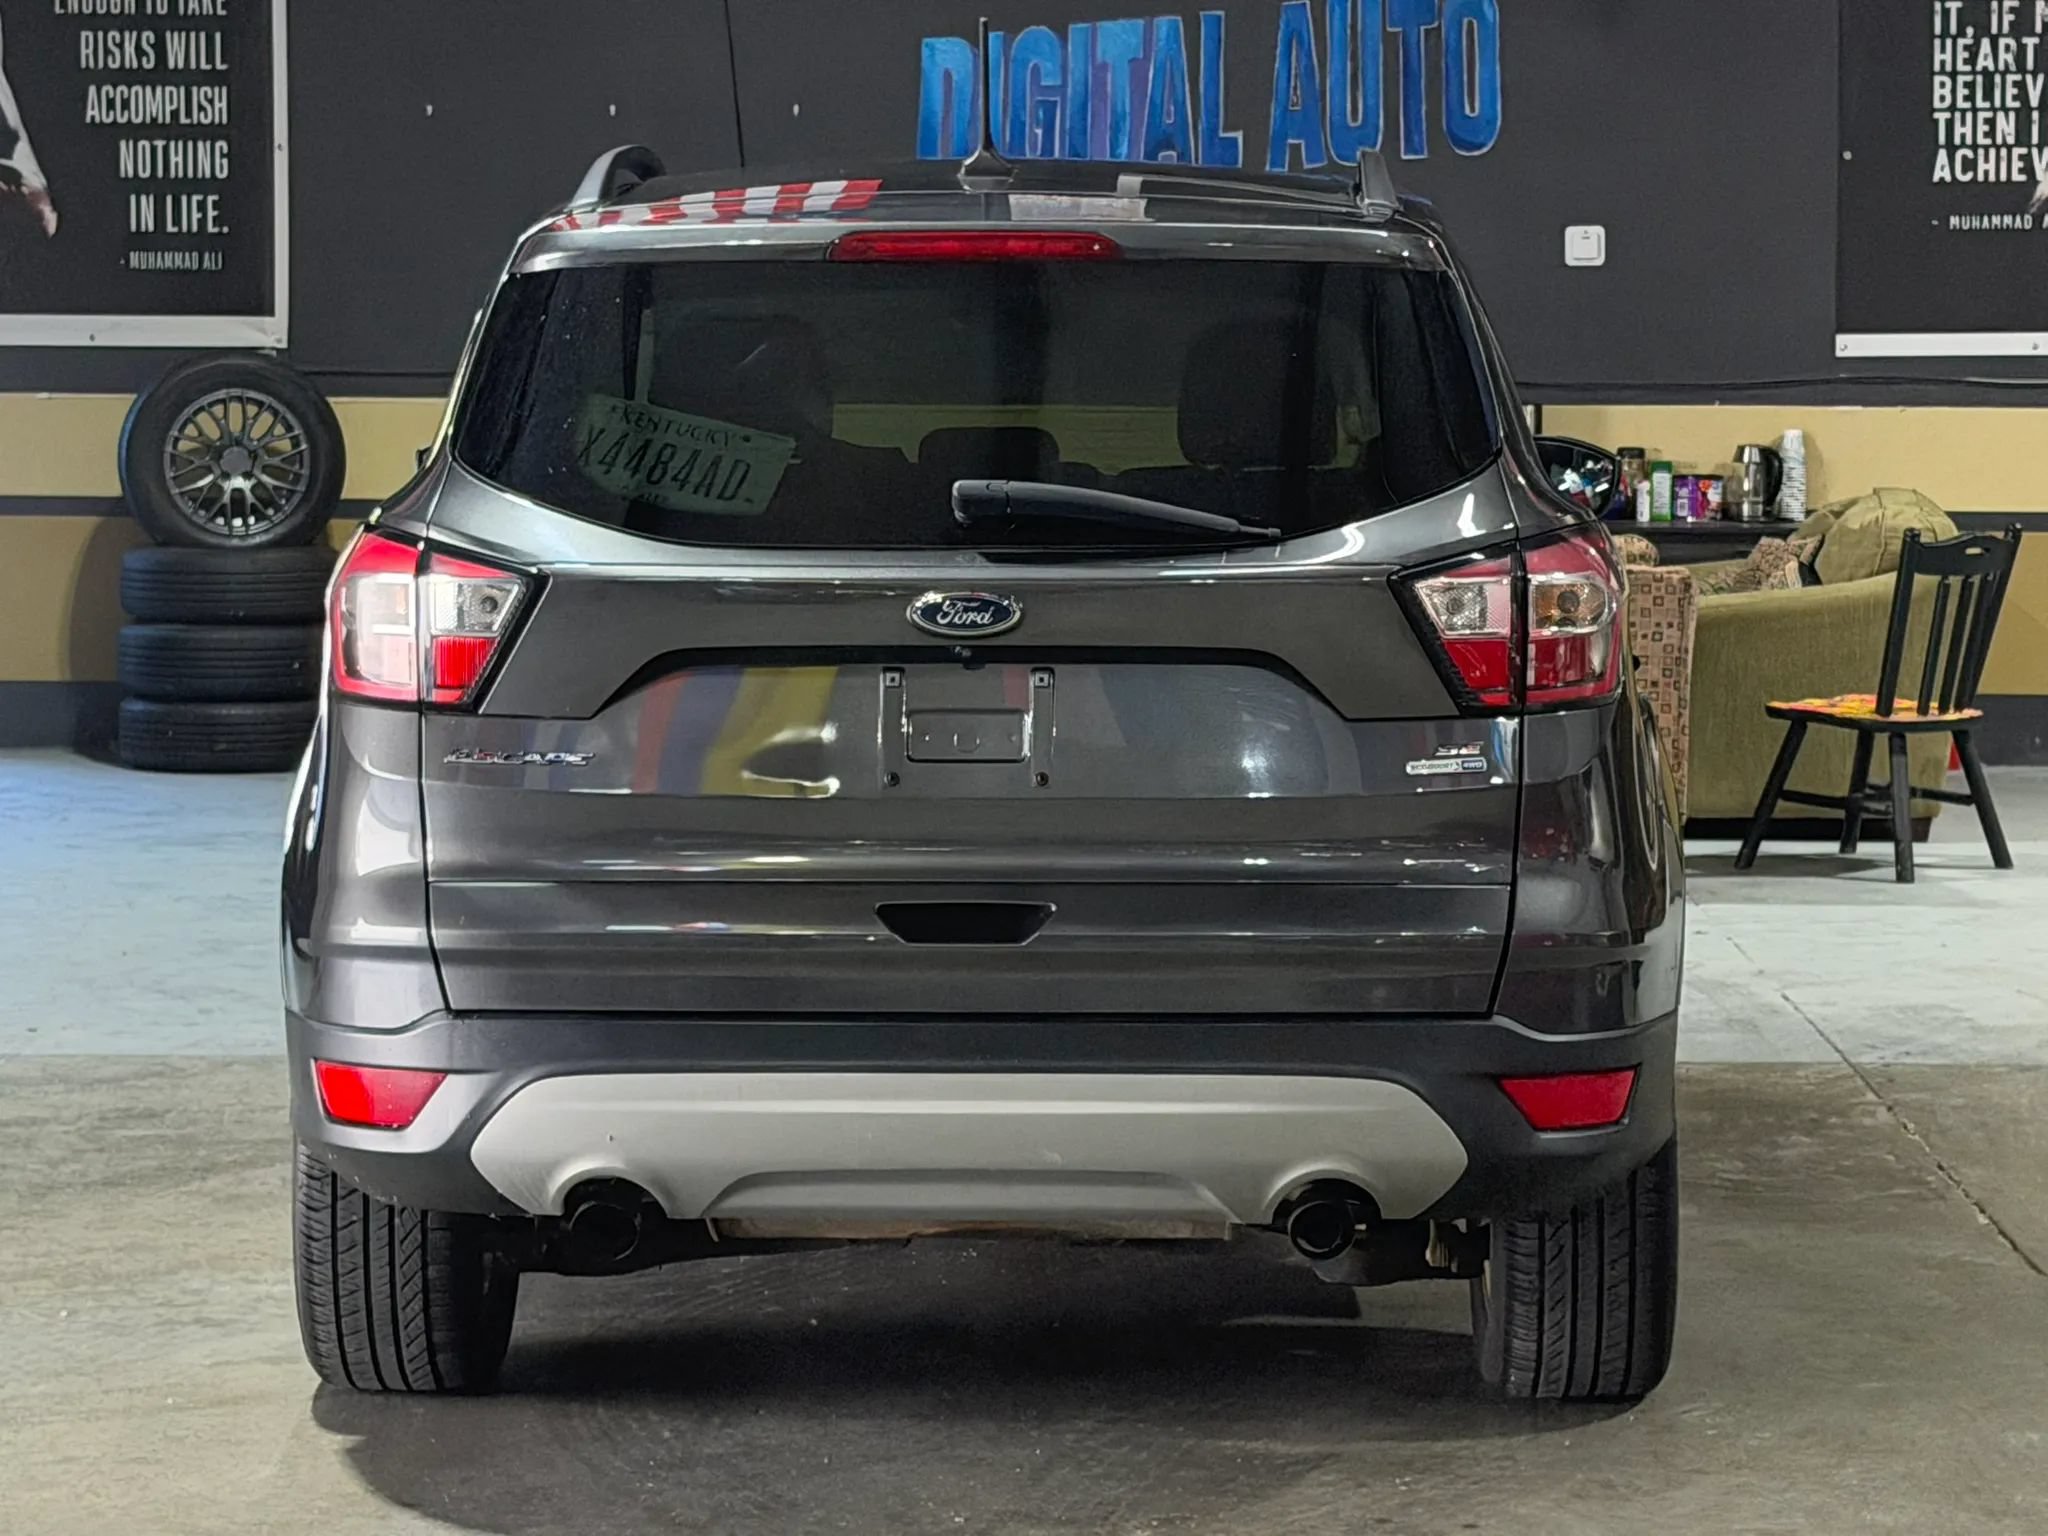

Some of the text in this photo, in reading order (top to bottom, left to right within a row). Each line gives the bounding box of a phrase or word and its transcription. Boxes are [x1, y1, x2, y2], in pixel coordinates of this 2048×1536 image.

[1934, 0, 1974, 38] IT,
[1991, 0, 2020, 34] IF
[80, 30, 229, 70] RISKS WILL
[1934, 36, 2040, 72] HEART
[85, 84, 228, 125] ACCOMPLISH
[916, 0, 1502, 171] DIGITAL AUTO
[1933, 110, 2039, 146] THEN I
[119, 139, 229, 179] NOTHING
[130, 194, 230, 233] IN LIFE.
[1949, 214, 2033, 230] MUHAMMAD
[129, 250, 199, 270] MUHAMMAD
[203, 251, 223, 271] ALI
[621, 402, 735, 448] KENTUCKY
[936, 599, 995, 625] Ford
